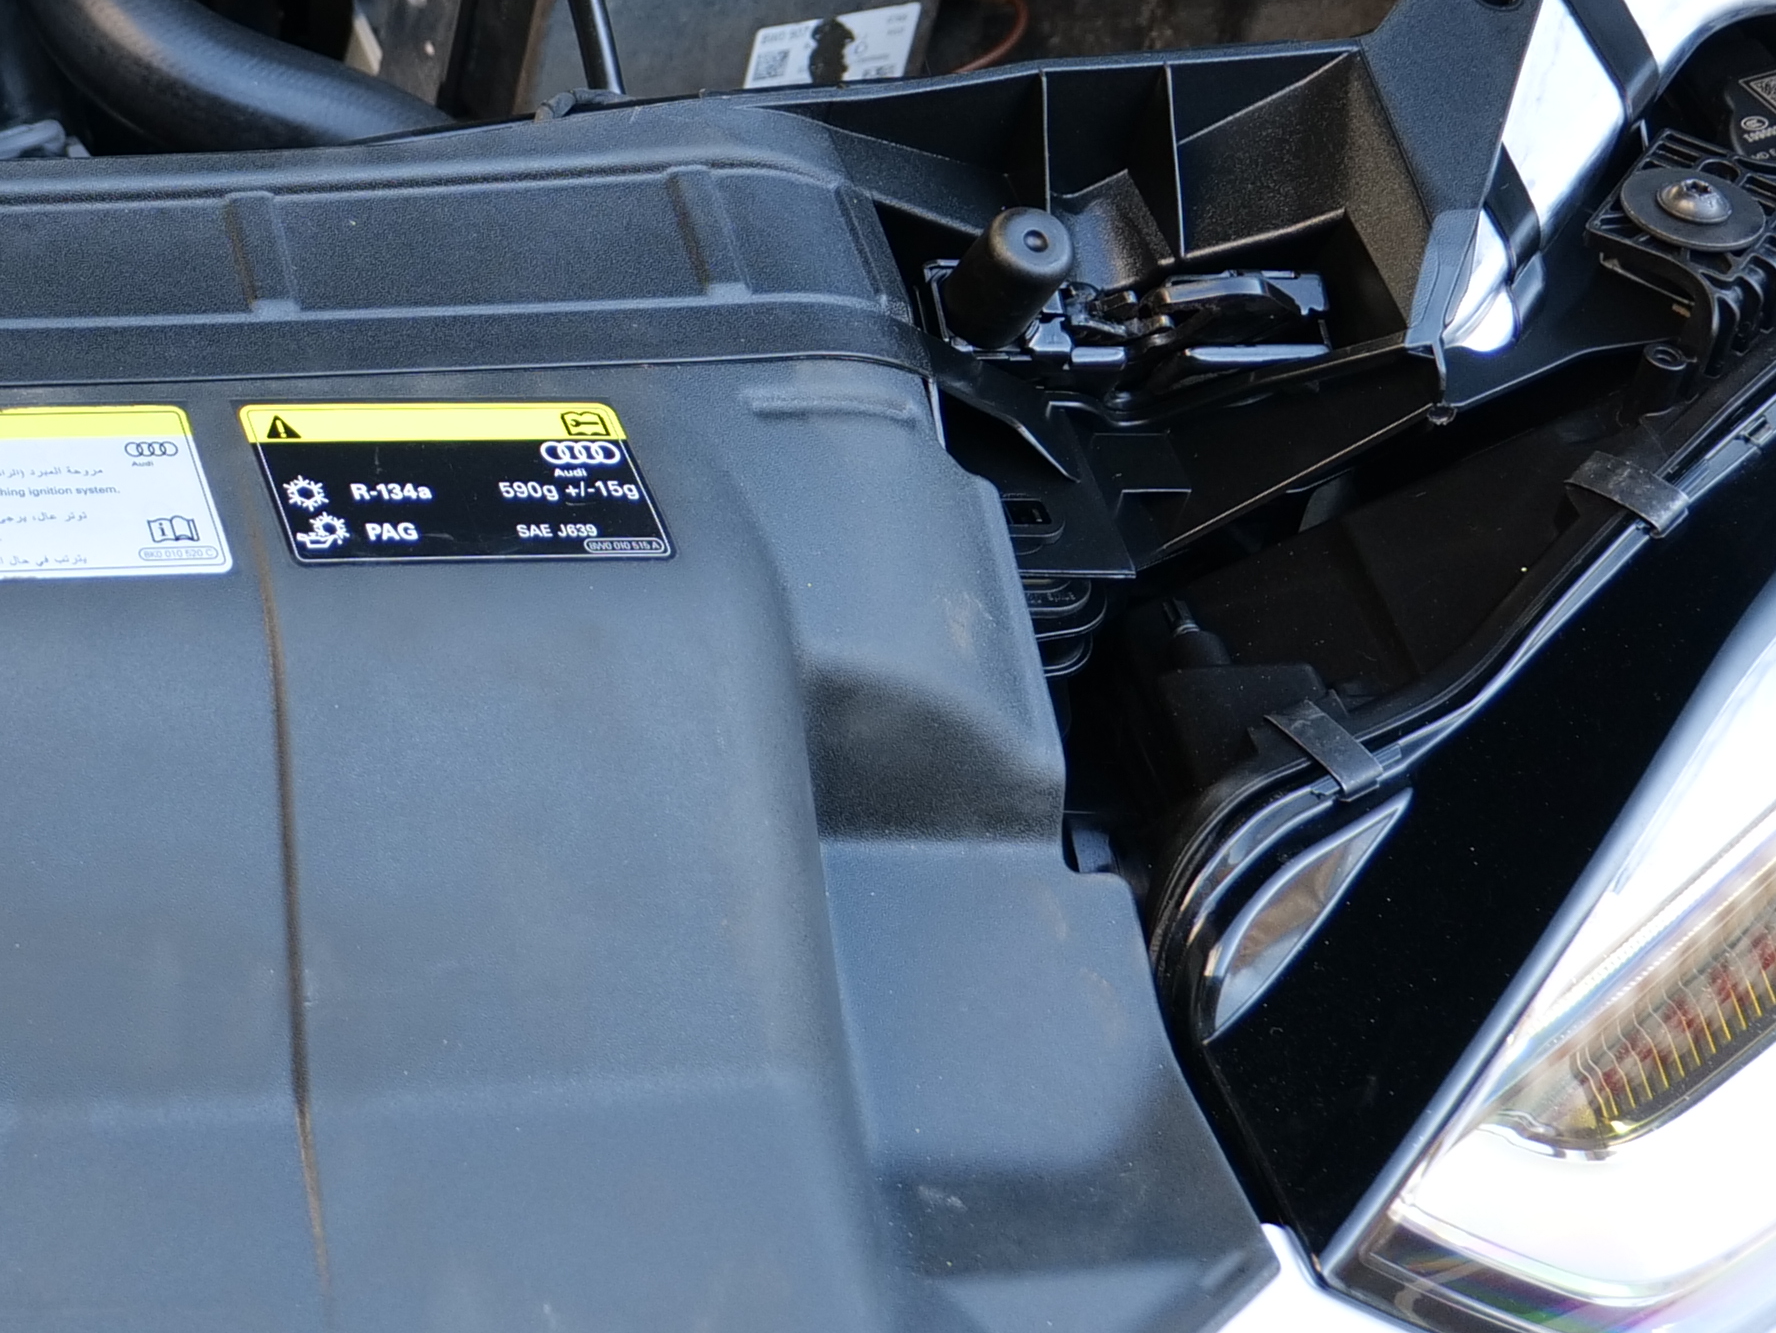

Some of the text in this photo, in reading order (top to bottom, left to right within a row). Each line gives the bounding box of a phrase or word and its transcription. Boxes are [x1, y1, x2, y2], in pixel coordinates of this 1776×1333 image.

[554, 468, 587, 477] Audi
[28, 486, 73, 497] ignition
[76, 486, 120, 496] system.
[350, 480, 640, 501] R-134a 590g +/-15g
[365, 522, 598, 540] PAG SAE J639
[652, 540, 660, 549] A
